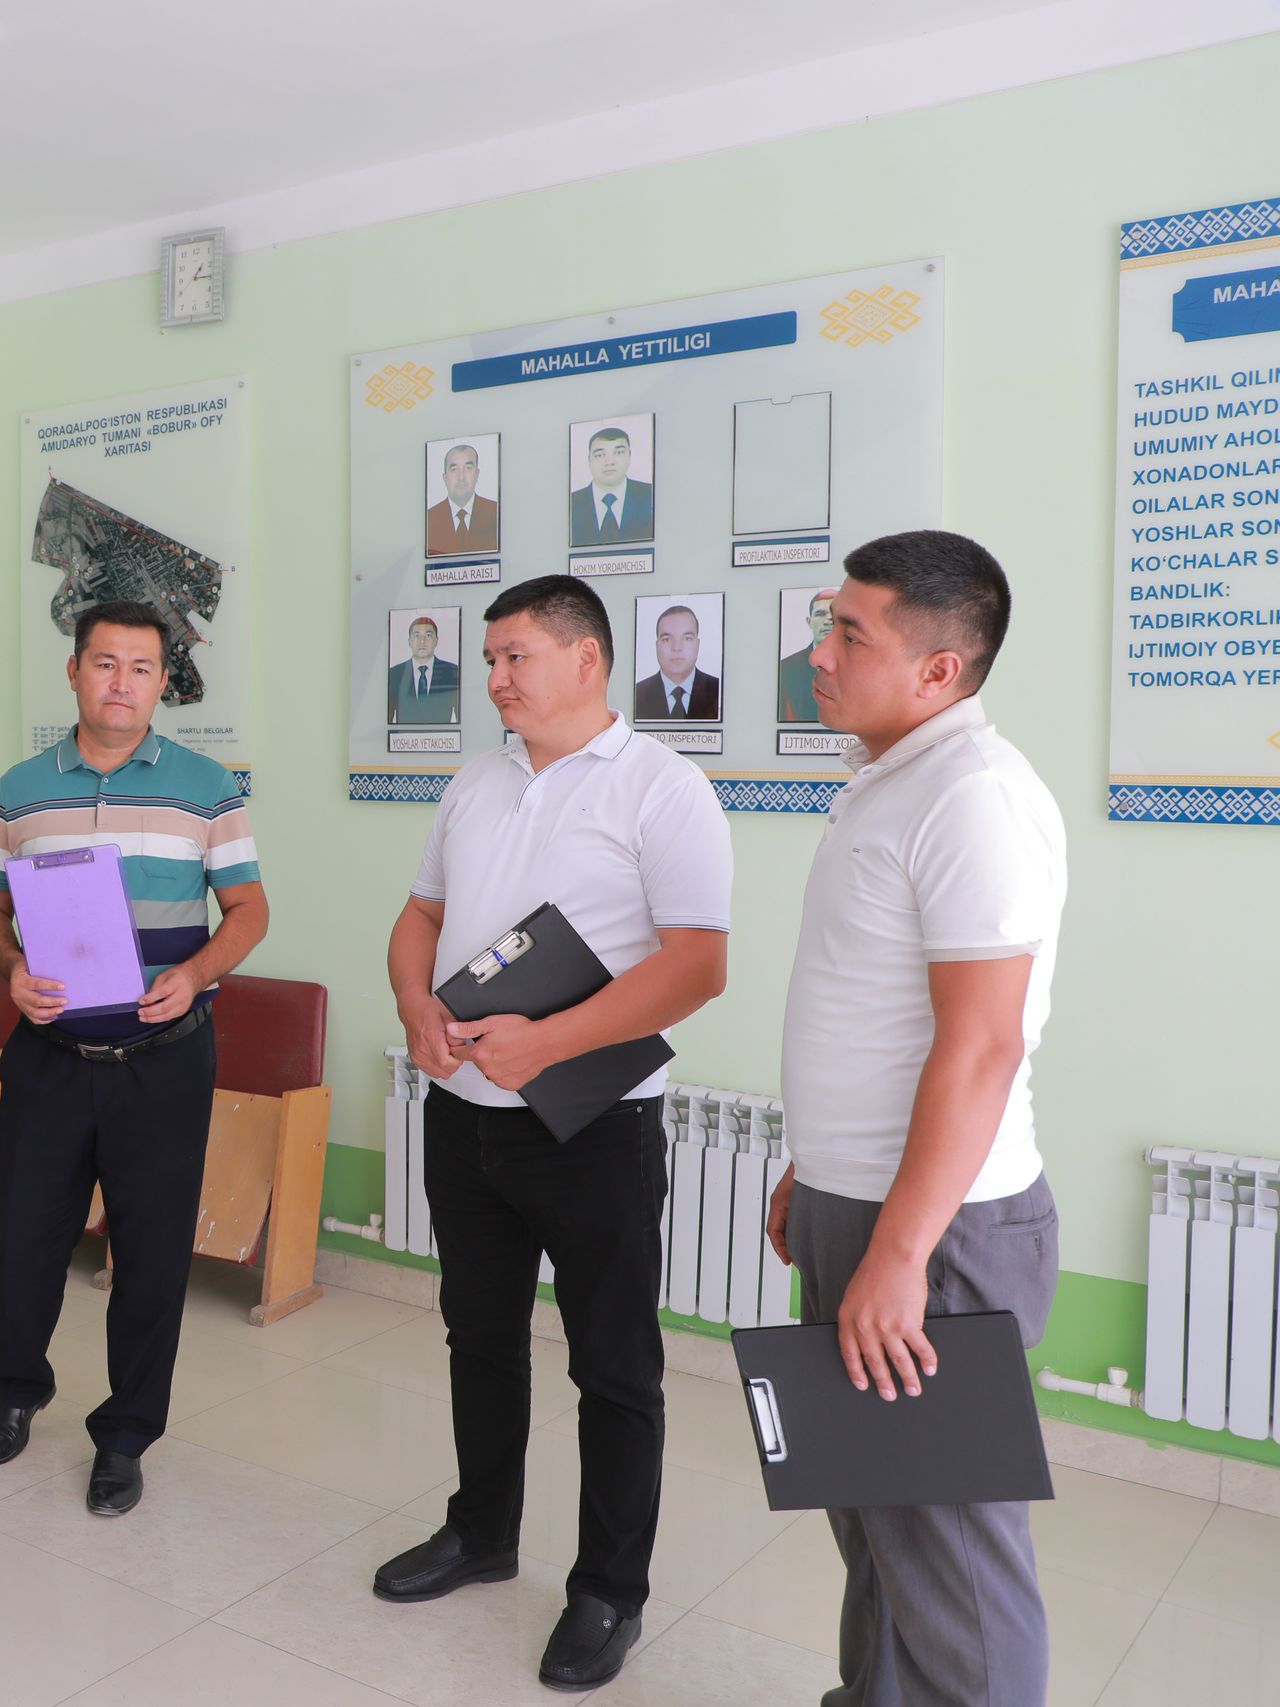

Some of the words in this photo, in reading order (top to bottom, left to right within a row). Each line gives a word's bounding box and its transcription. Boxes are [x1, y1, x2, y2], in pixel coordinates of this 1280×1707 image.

[521, 348, 609, 375] MAHALLA
[618, 331, 711, 361] YETTILIGI
[1134, 374, 1224, 398] TASHKIL
[146, 398, 227, 421] RESPUBLIKASI
[1134, 405, 1209, 428] HUDUD
[40, 434, 96, 453] AMUDARYO
[101, 427, 141, 443] TUMANI
[146, 418, 197, 436] «BOBUR»
[200, 414, 223, 428] OFY
[104, 441, 151, 457] XARITASI
[1133, 433, 1219, 456] UMUMIY
[1132, 493, 1225, 514] OILALAR
[1131, 522, 1234, 543] YOSHLAR
[739, 550, 782, 562] PROFILAKTIKA
[783, 547, 820, 560] INSPEKTORI
[430, 570, 468, 582] MAHALLA
[470, 567, 494, 579] RAISI
[573, 564, 596, 574] HOKIM
[597, 560, 646, 573] YORDAMCHISI
[1130, 582, 1230, 601] BANDLIK:
[1129, 609, 1280, 630] TADBIRKORLI
[1128, 641, 1217, 659] IJTIMOIY
[1128, 670, 1236, 688] TOMORQA
[177, 727, 201, 735] SHARTLI
[203, 727, 233, 735] BELGILAR
[668, 734, 717, 744] INSPEKTORI
[392, 738, 419, 750] YOSHLAR
[420, 737, 455, 749] YETAKCHISI
[785, 737, 831, 749] IJTIMOIY
